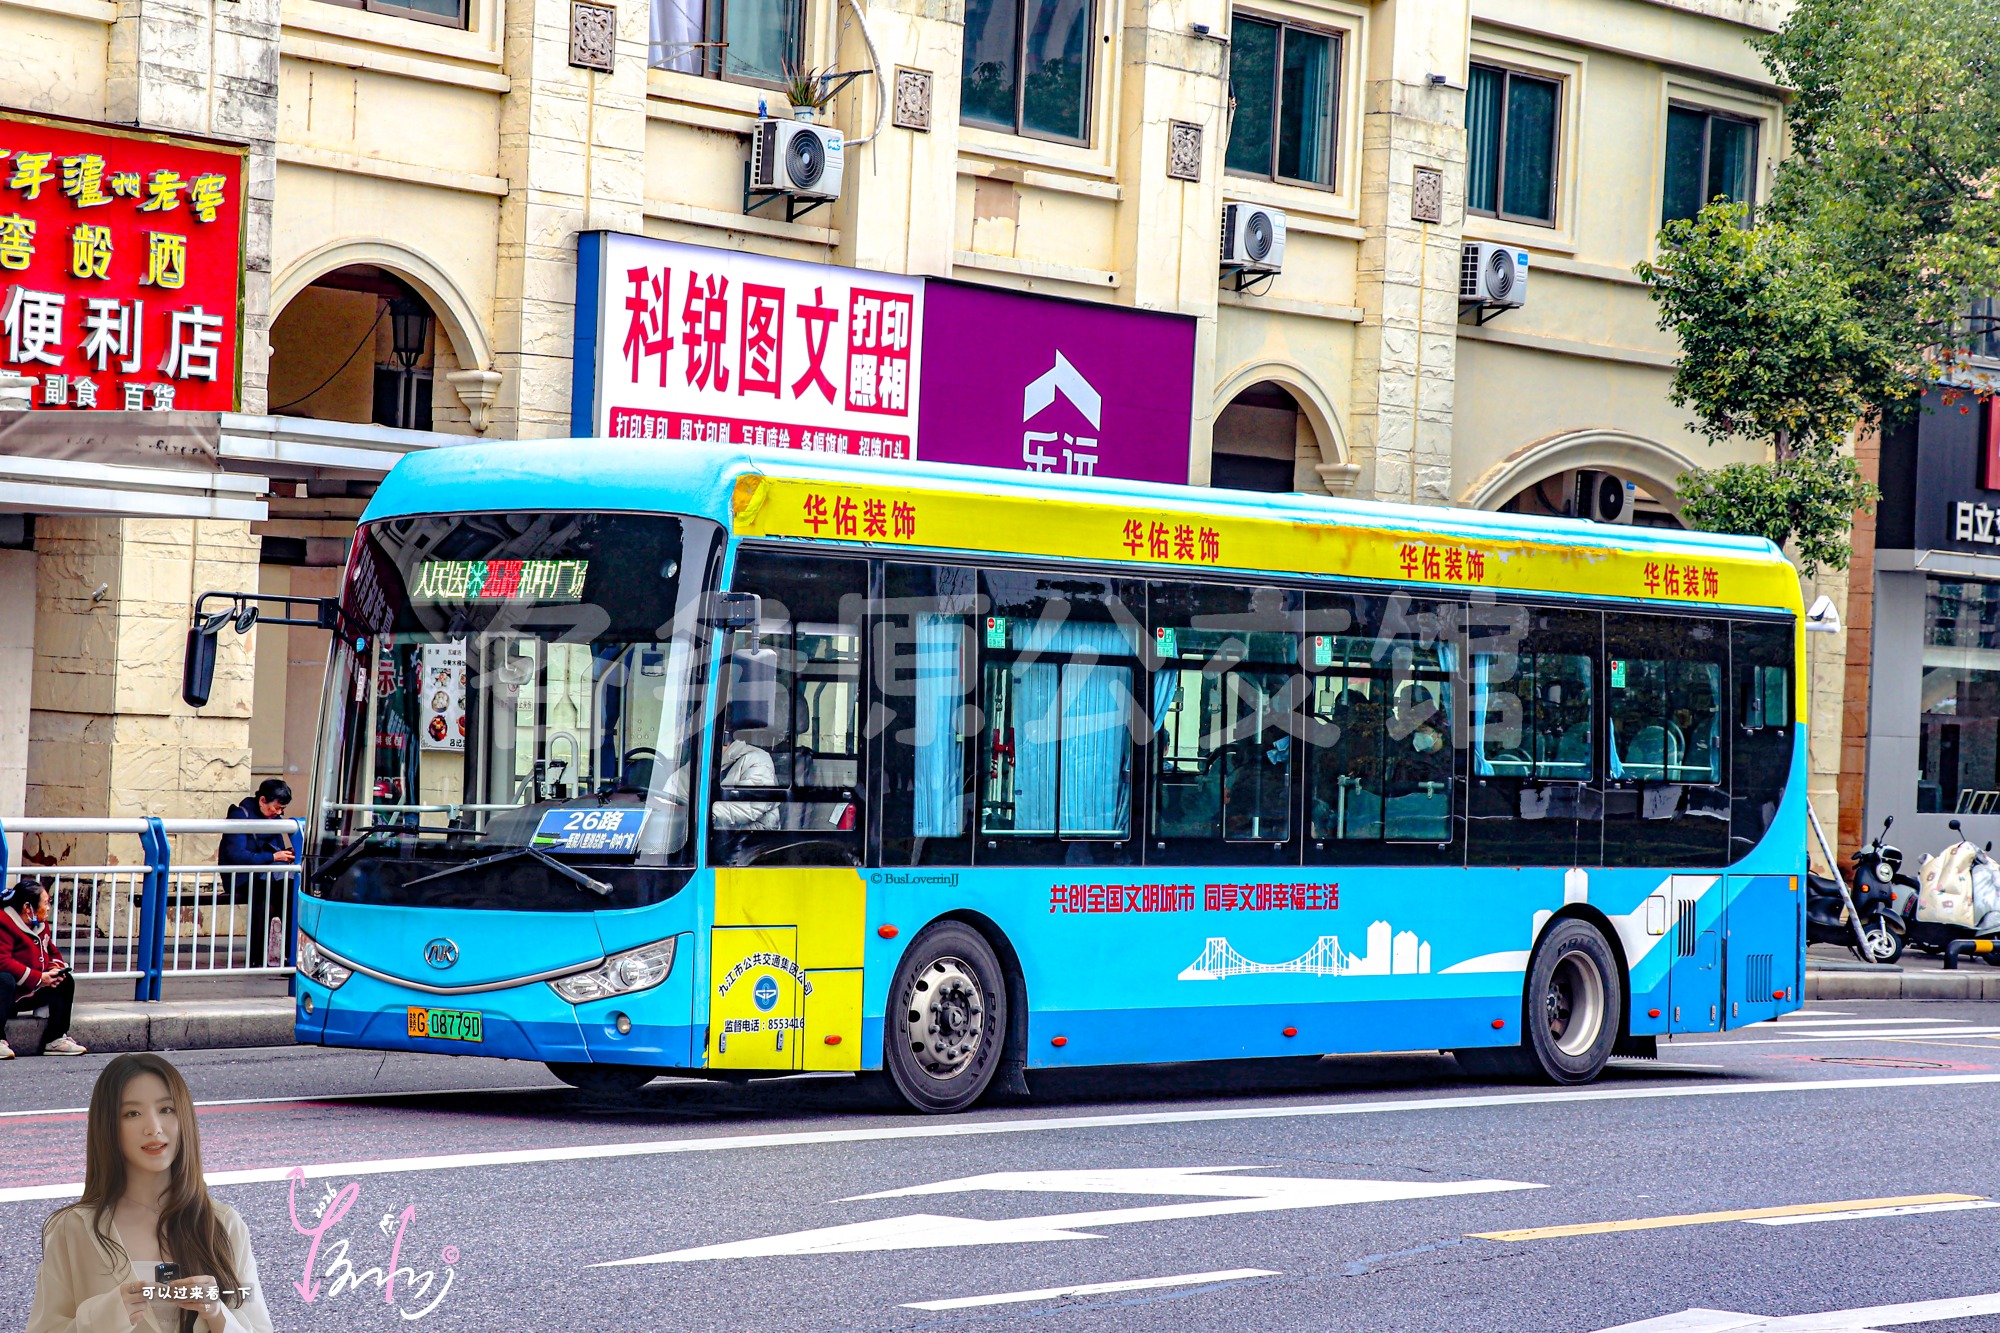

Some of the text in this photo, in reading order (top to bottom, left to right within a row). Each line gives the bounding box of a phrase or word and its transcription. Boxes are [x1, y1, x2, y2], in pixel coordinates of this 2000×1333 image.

[0, 149, 227, 222] 年泸州老窖
[0, 213, 187, 290] 窖龄酒
[4, 284, 224, 382] 便利店
[622, 266, 839, 405] 科锐图文
[852, 295, 908, 351] 打印
[44, 374, 175, 411] 副食 百货
[849, 353, 908, 410] 照相
[616, 412, 668, 438] 打印复印
[680, 419, 730, 443] 图文印刷
[741, 425, 790, 449] 写真喷绘
[803, 493, 916, 540] 华佑装饰
[1955, 500, 2000, 546] 日立
[1122, 518, 1220, 564] 华佑装饰
[1400, 543, 1485, 583] 华佑装饰
[1643, 562, 1719, 598] 华佑装饰
[563, 811, 625, 831] 26路
[1049, 883, 1339, 913] 共创全国文明城市 同享文明幸福生活
[718, 952, 814, 997] 九江市公共交通集团公司
